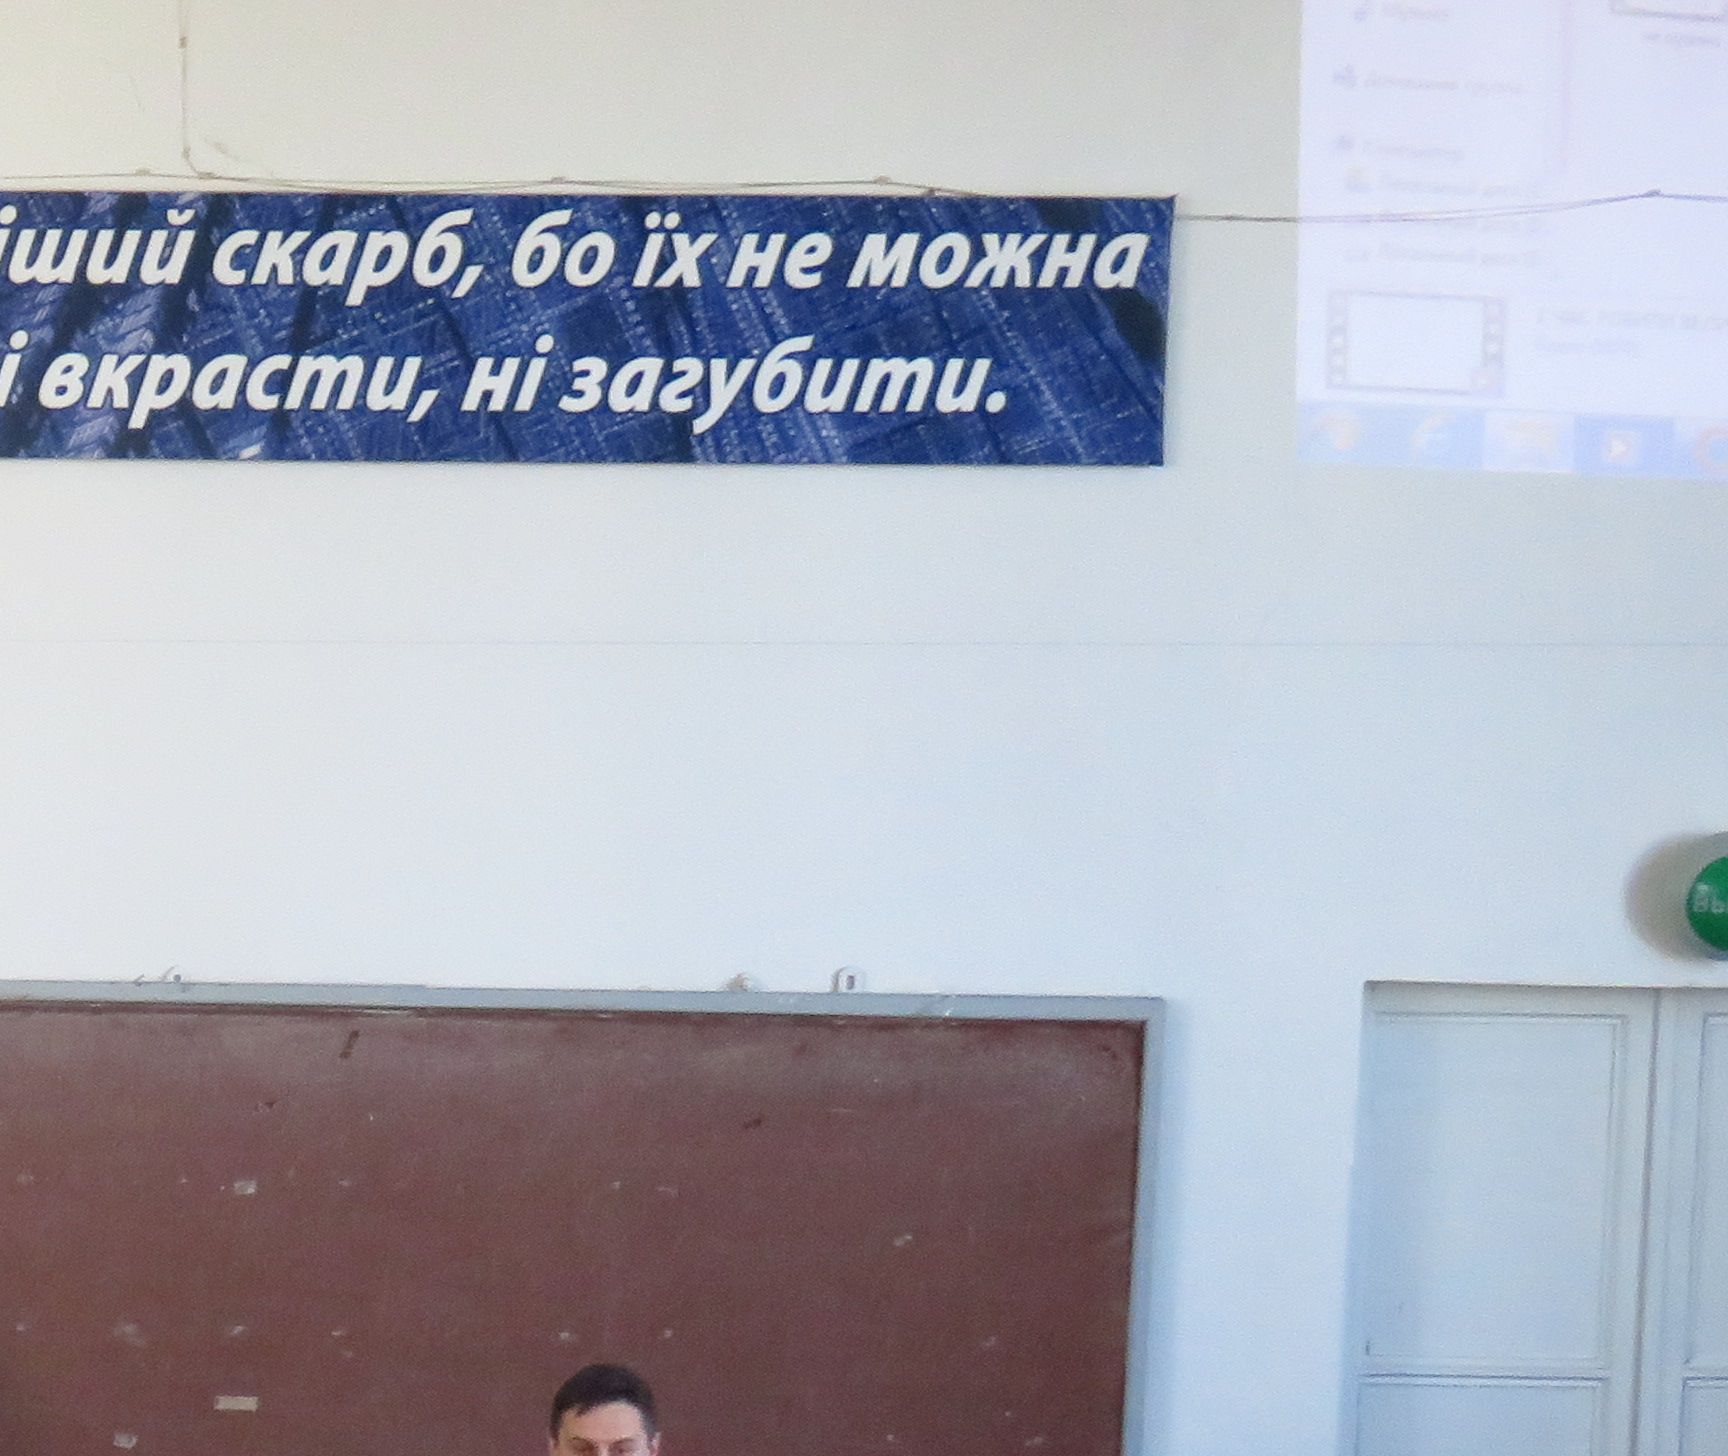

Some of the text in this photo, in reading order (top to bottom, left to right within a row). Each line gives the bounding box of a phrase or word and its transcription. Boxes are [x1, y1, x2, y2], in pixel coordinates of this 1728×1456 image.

[211, 209, 484, 306] скарб,
[511, 209, 616, 288] бо
[632, 212, 719, 289] їх
[726, 232, 834, 289] не
[847, 232, 1150, 290] можна
[37, 353, 440, 429] вкрасти,
[460, 334, 555, 412] ні
[557, 336, 1007, 435] загубити.
